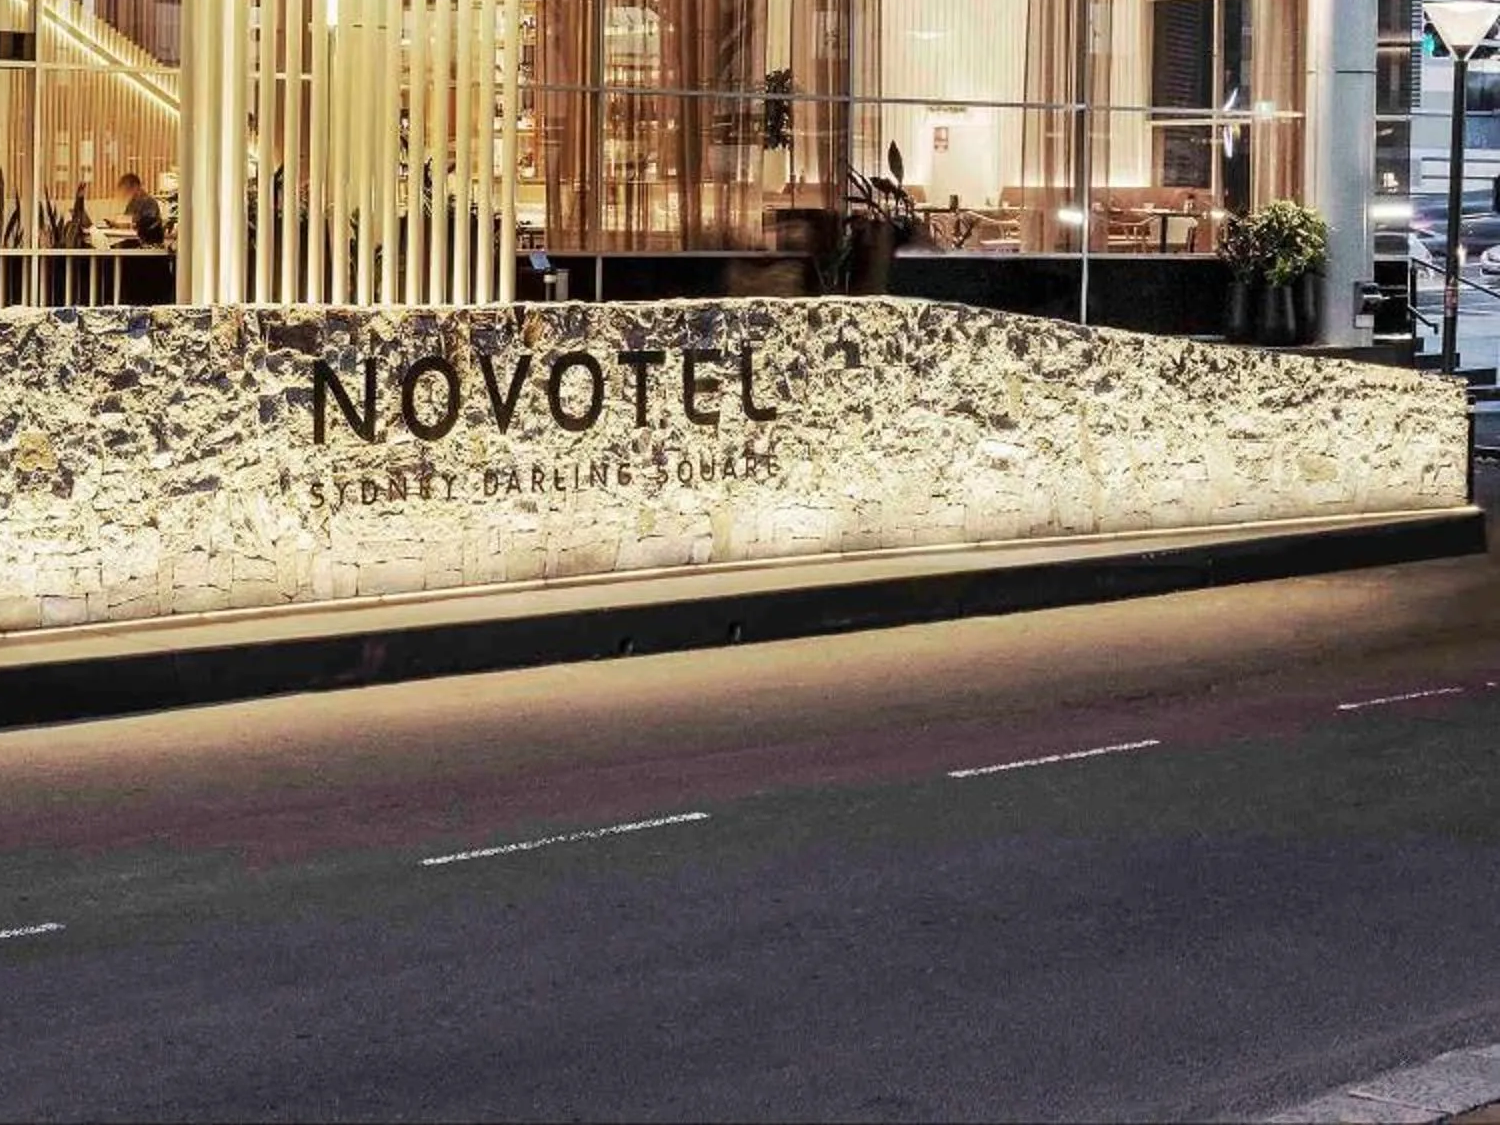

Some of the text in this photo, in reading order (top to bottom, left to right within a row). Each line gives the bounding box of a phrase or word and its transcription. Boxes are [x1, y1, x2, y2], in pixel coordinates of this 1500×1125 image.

[313, 347, 777, 444] NOVOTEL
[310, 454, 780, 508] SYDNEY DARLING SQUARE
